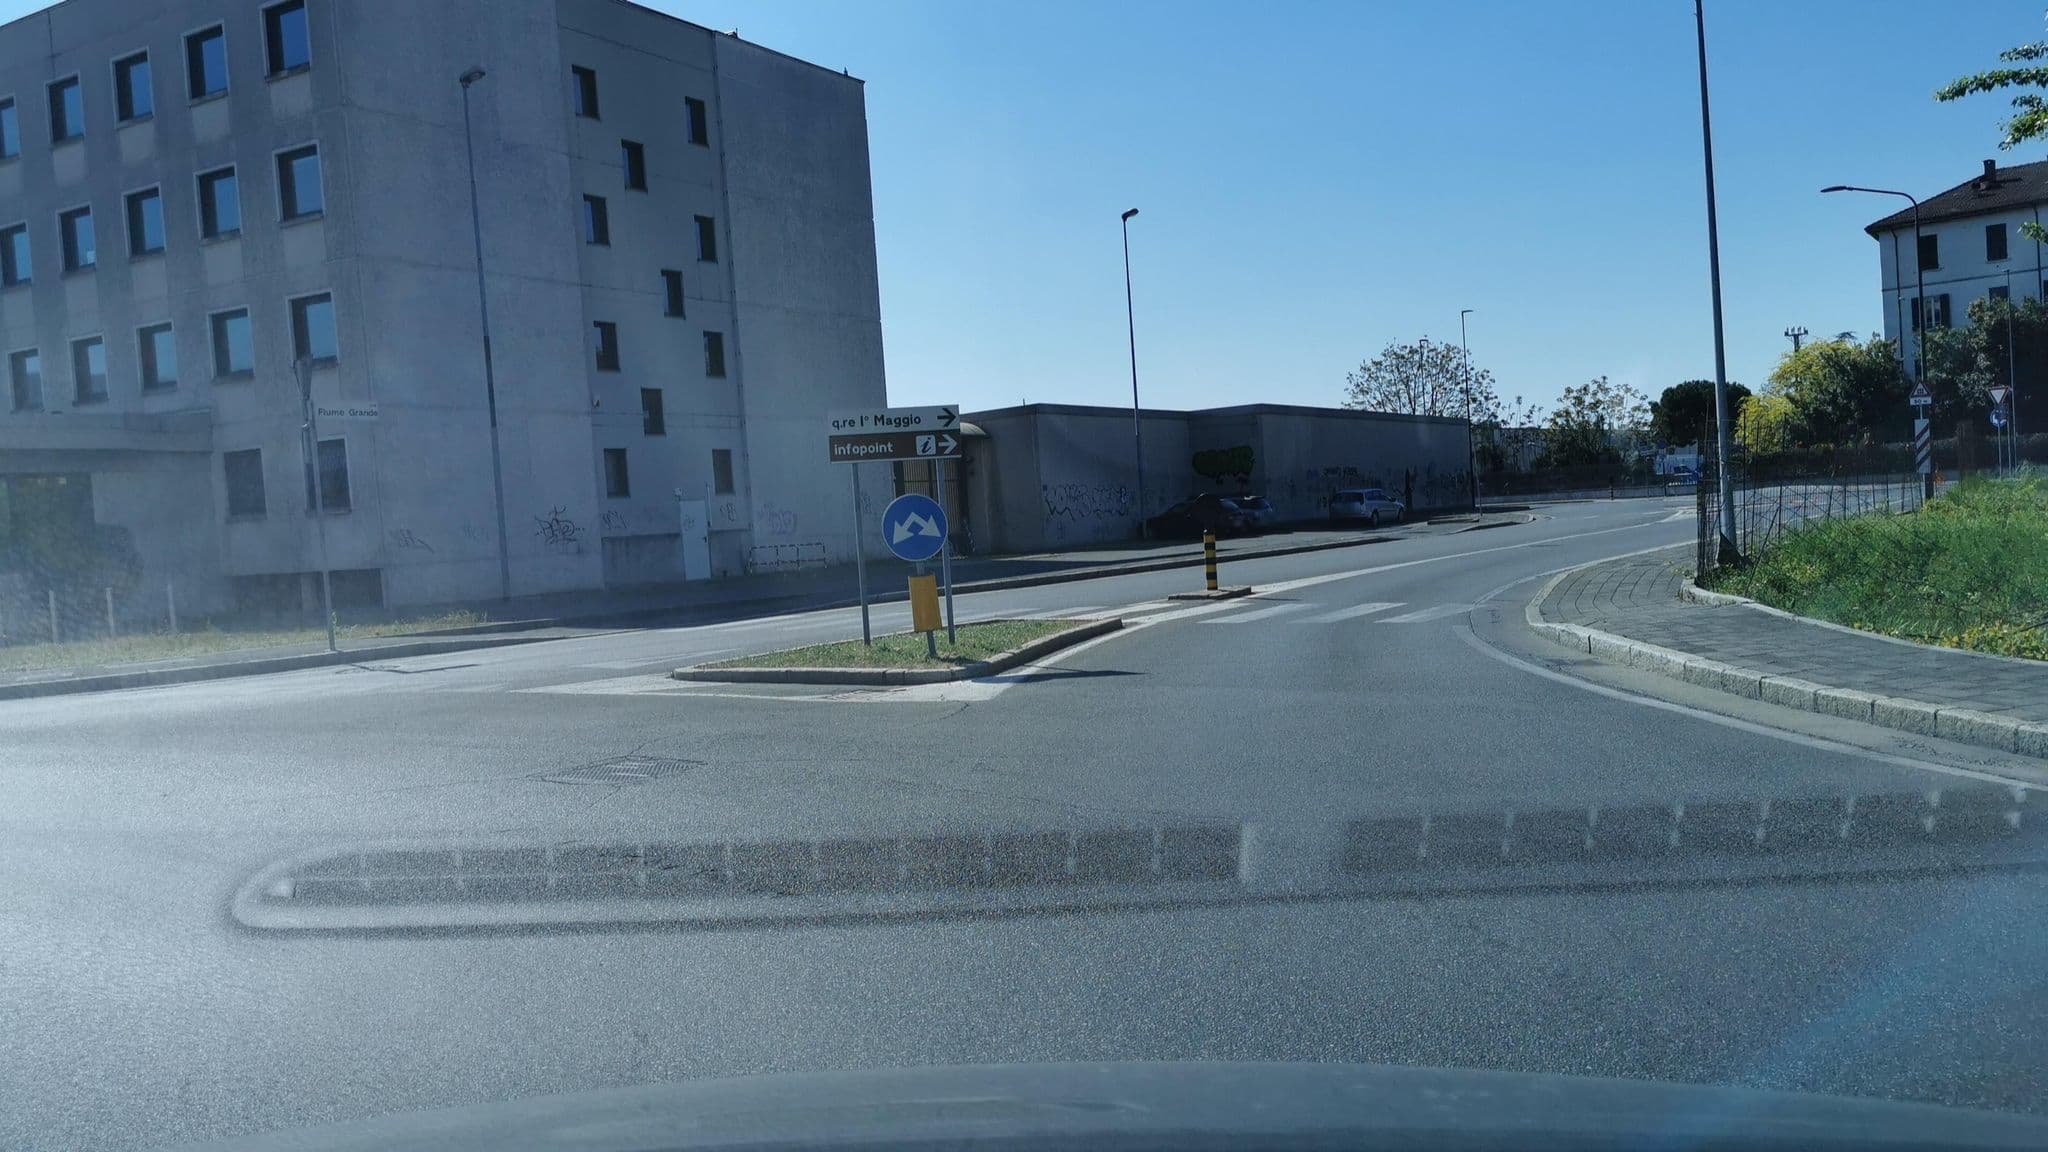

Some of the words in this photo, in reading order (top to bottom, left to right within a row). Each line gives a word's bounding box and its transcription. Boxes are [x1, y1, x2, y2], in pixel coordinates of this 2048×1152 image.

[318, 407, 345, 417] Fiume
[348, 408, 378, 417] Grande
[832, 418, 856, 431] q.re
[874, 414, 922, 428] Maggio
[834, 442, 894, 457] infopoint
